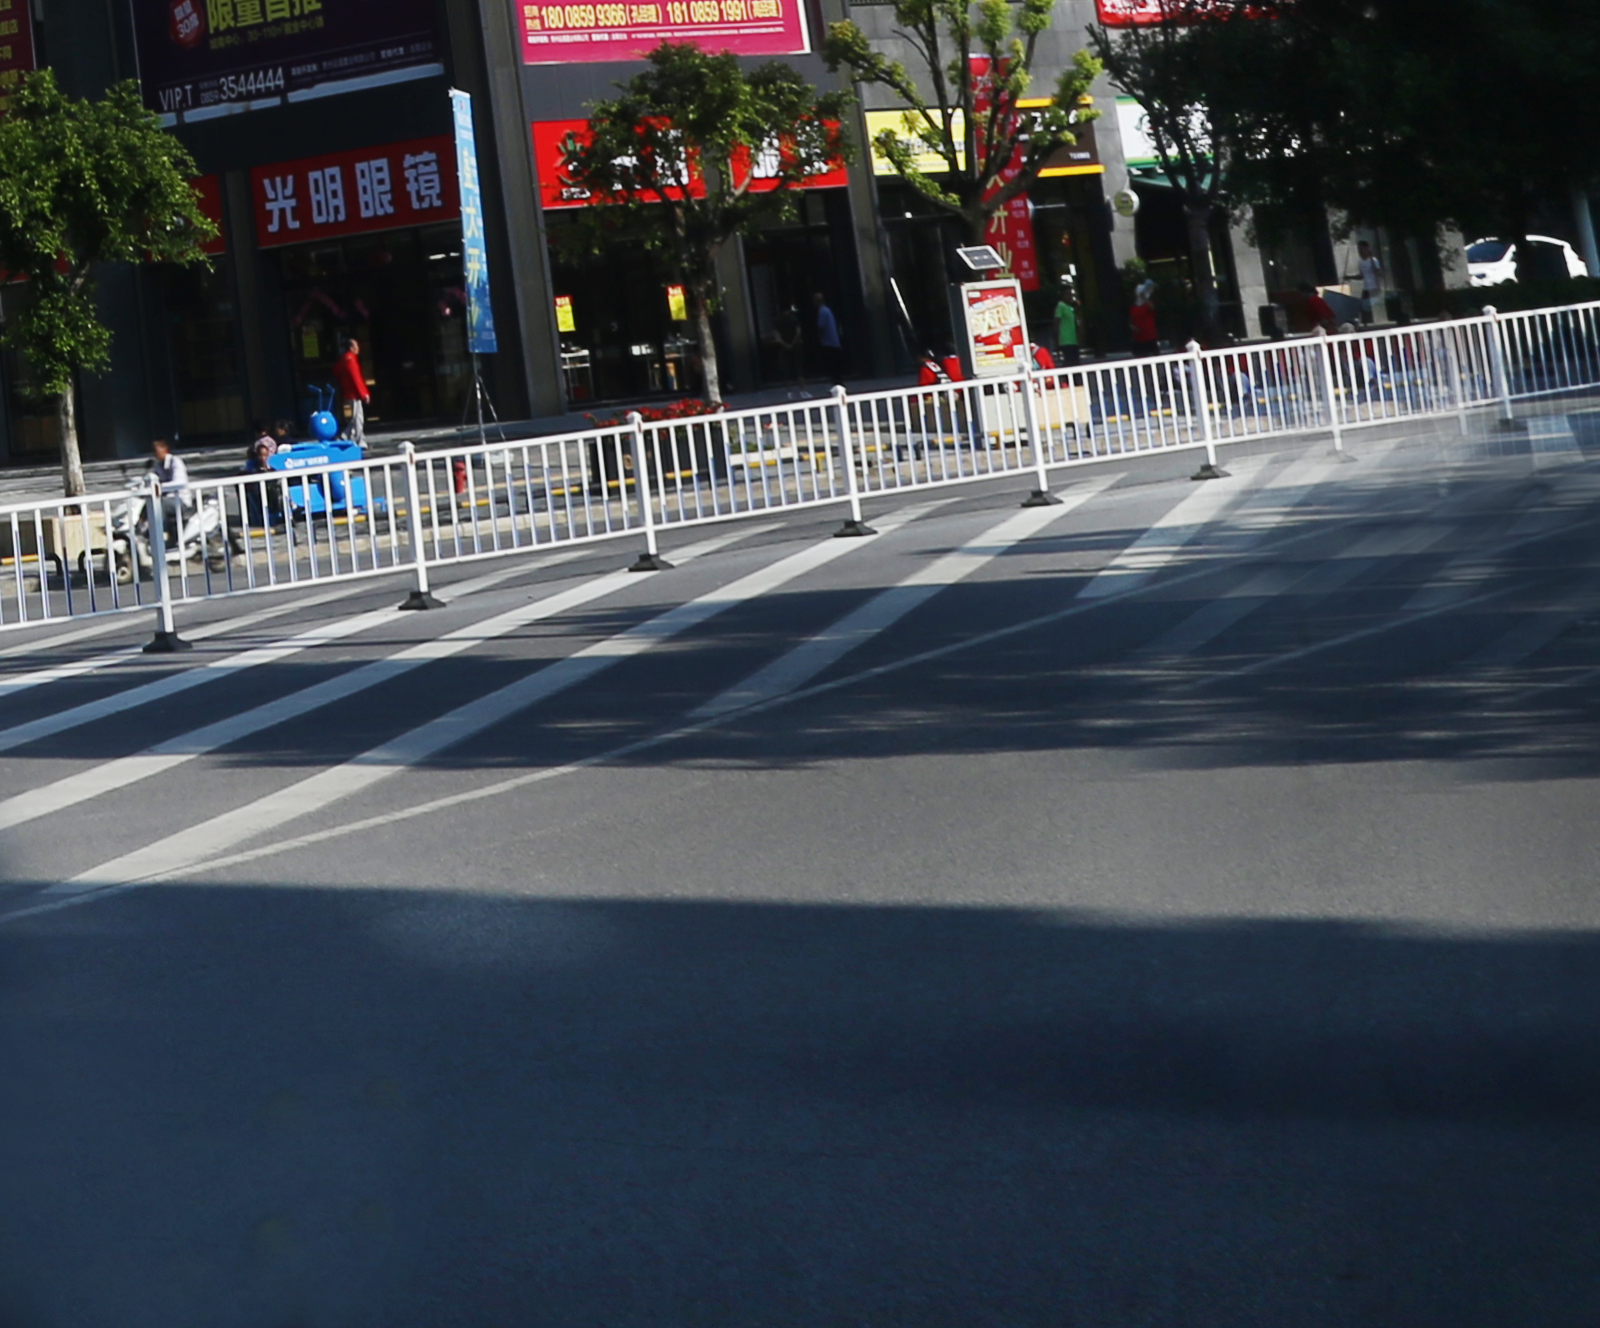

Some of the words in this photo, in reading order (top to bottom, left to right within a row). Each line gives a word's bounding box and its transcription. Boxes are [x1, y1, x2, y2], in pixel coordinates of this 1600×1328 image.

[541, 6, 564, 29] 180
[565, 4, 596, 28] 0859
[666, 1, 689, 23] 181
[690, 0, 720, 23] 0859
[219, 66, 284, 100] 3544444
[263, 151, 442, 232] 光明眼镜
